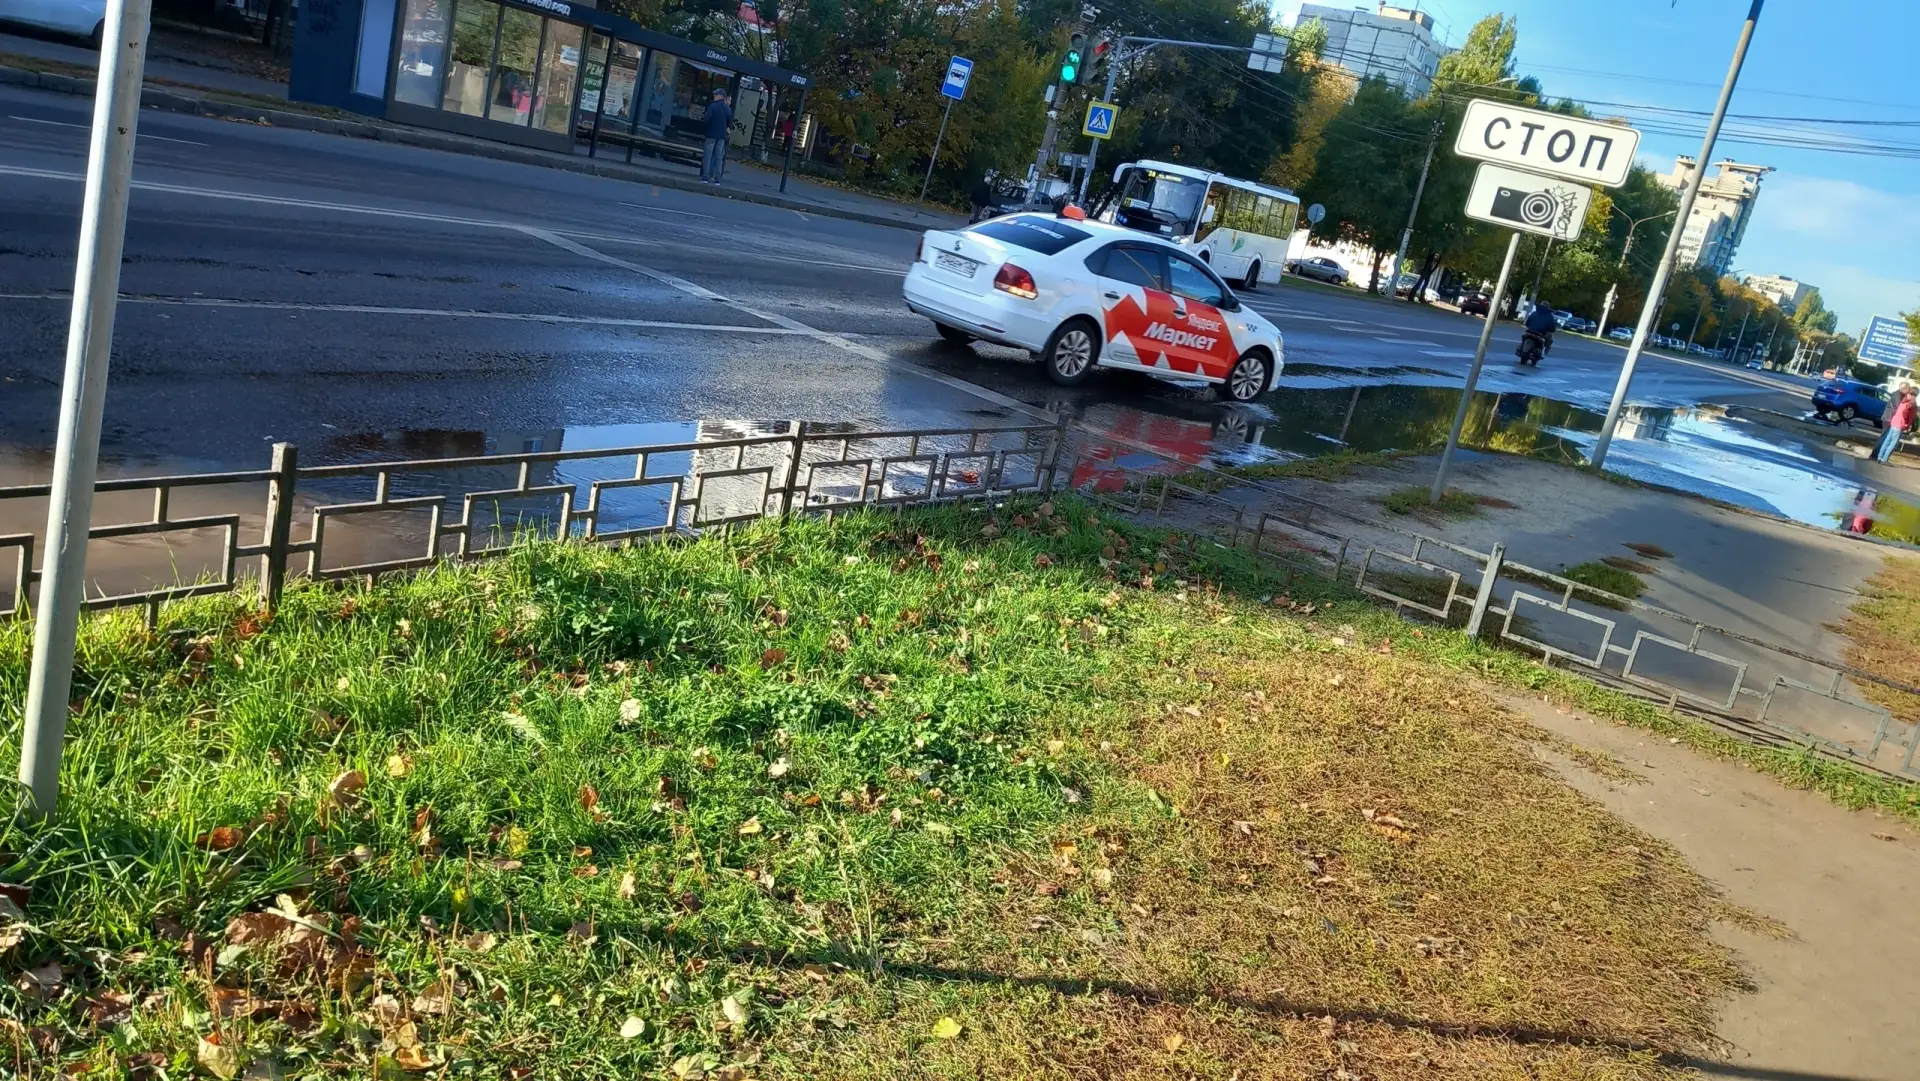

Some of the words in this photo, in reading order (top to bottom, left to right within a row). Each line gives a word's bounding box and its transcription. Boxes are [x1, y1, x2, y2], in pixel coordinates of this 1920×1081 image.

[1484, 117, 1613, 171] СТОП
[1143, 321, 1218, 351] Маркет
[1187, 313, 1222, 332] Яндекс
